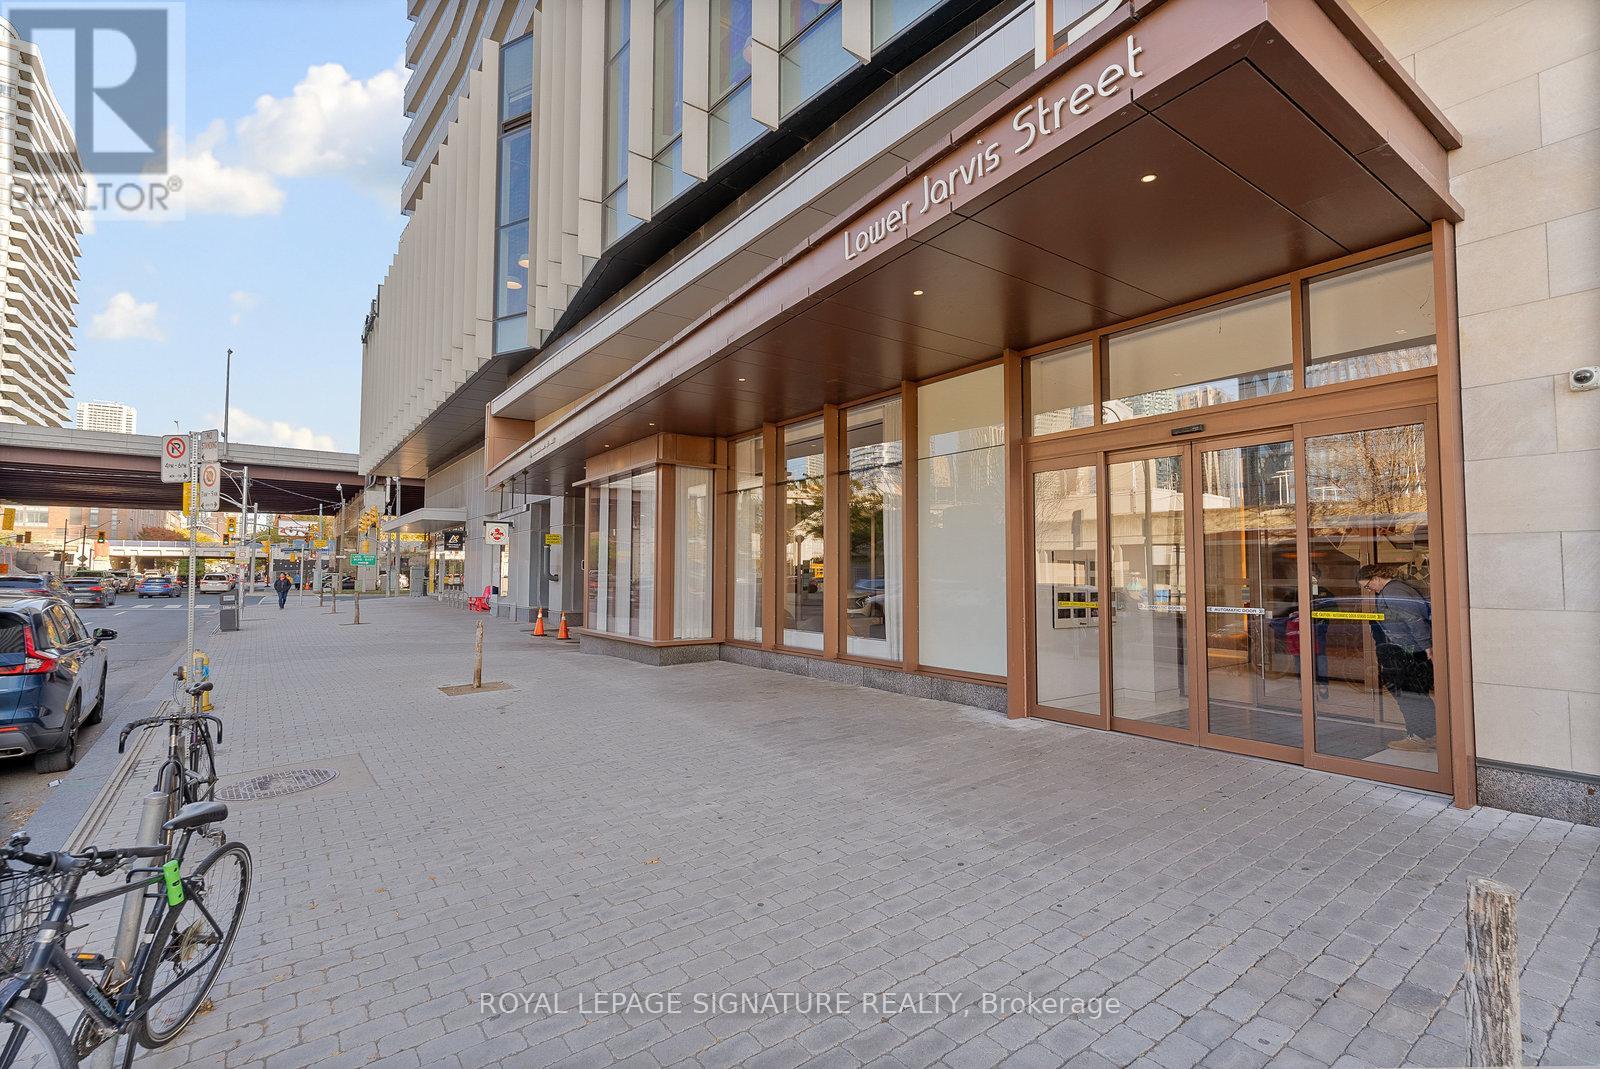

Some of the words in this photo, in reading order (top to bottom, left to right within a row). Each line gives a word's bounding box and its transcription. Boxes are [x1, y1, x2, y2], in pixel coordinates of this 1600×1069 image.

[844, 200, 912, 260] Lower
[920, 138, 1001, 214] Jarvis
[1011, 34, 1144, 155] Street
